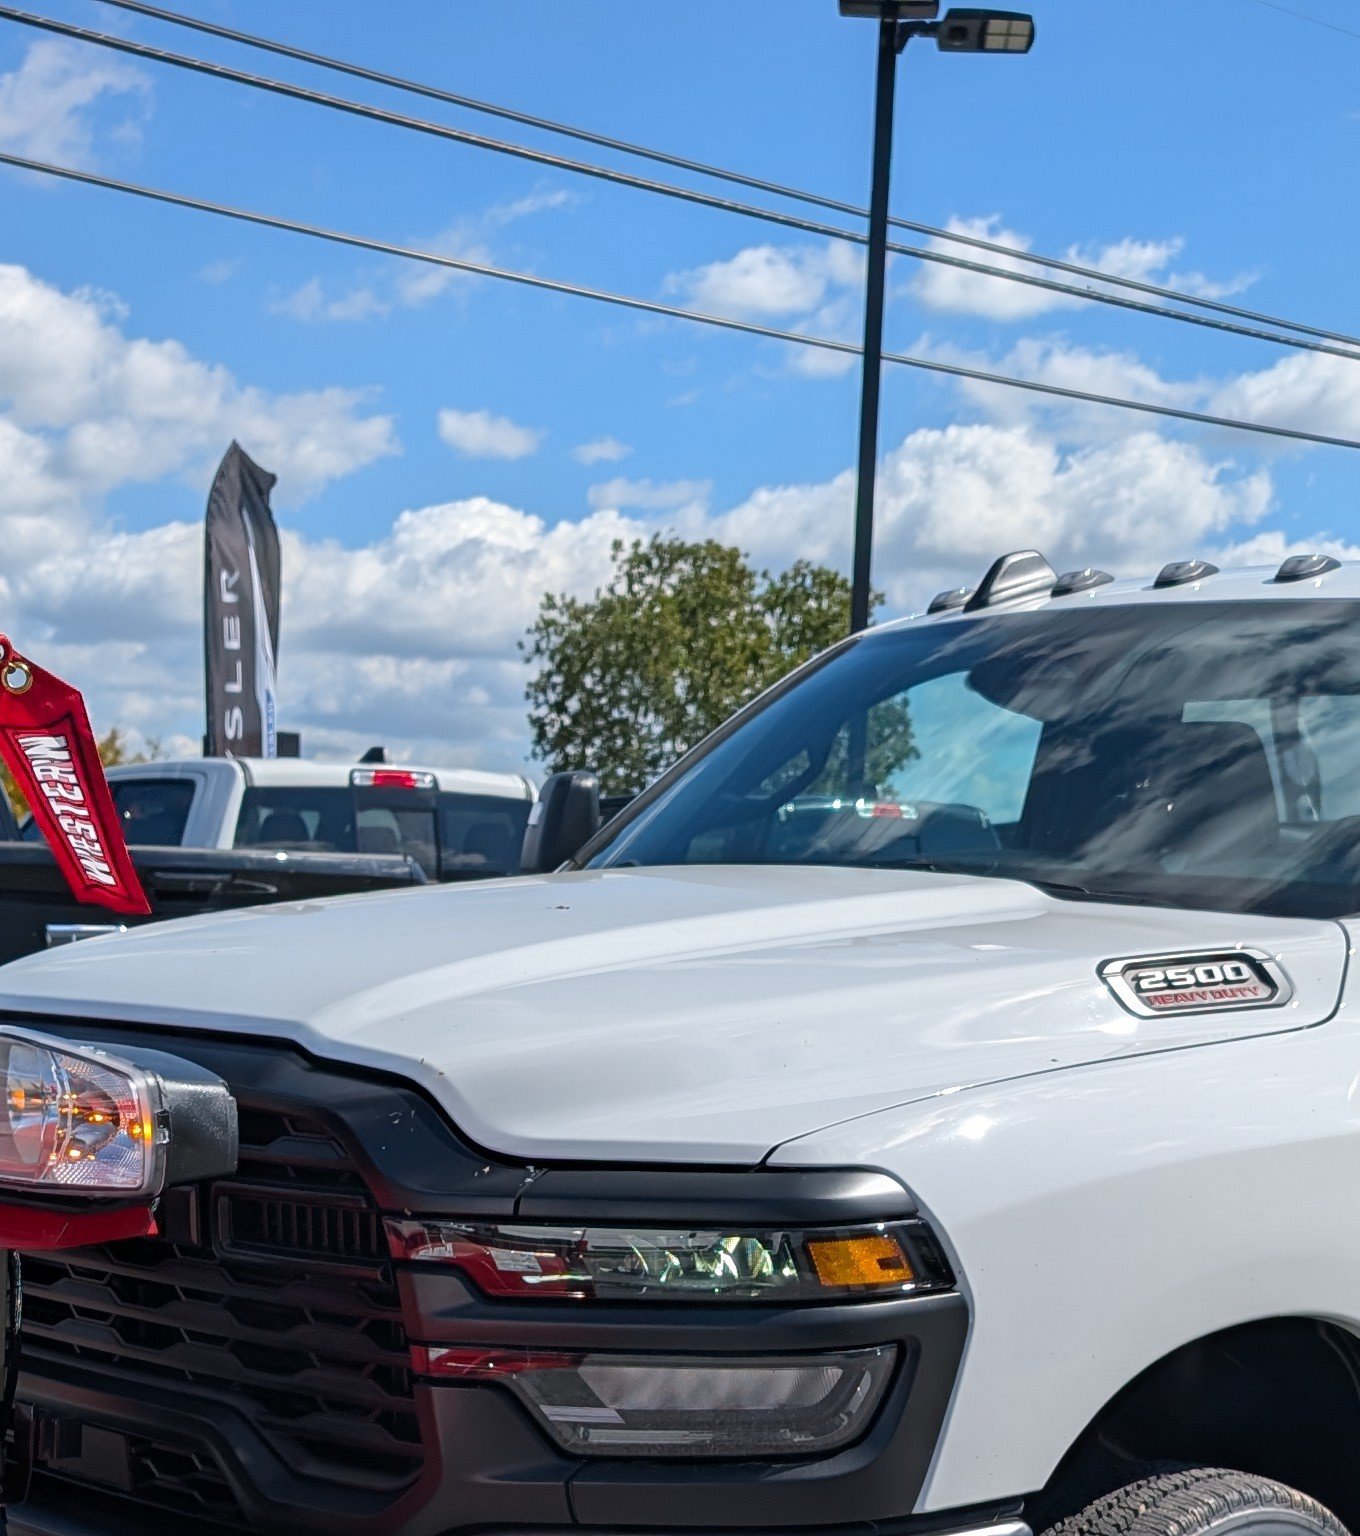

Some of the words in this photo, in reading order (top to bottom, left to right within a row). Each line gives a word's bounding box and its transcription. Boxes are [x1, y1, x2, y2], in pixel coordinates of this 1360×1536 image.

[17, 734, 117, 886] WESTERN
[1137, 963, 1251, 992] 2500
[1147, 991, 1209, 1006] HEAVY
[1208, 986, 1259, 1000] DUTY
